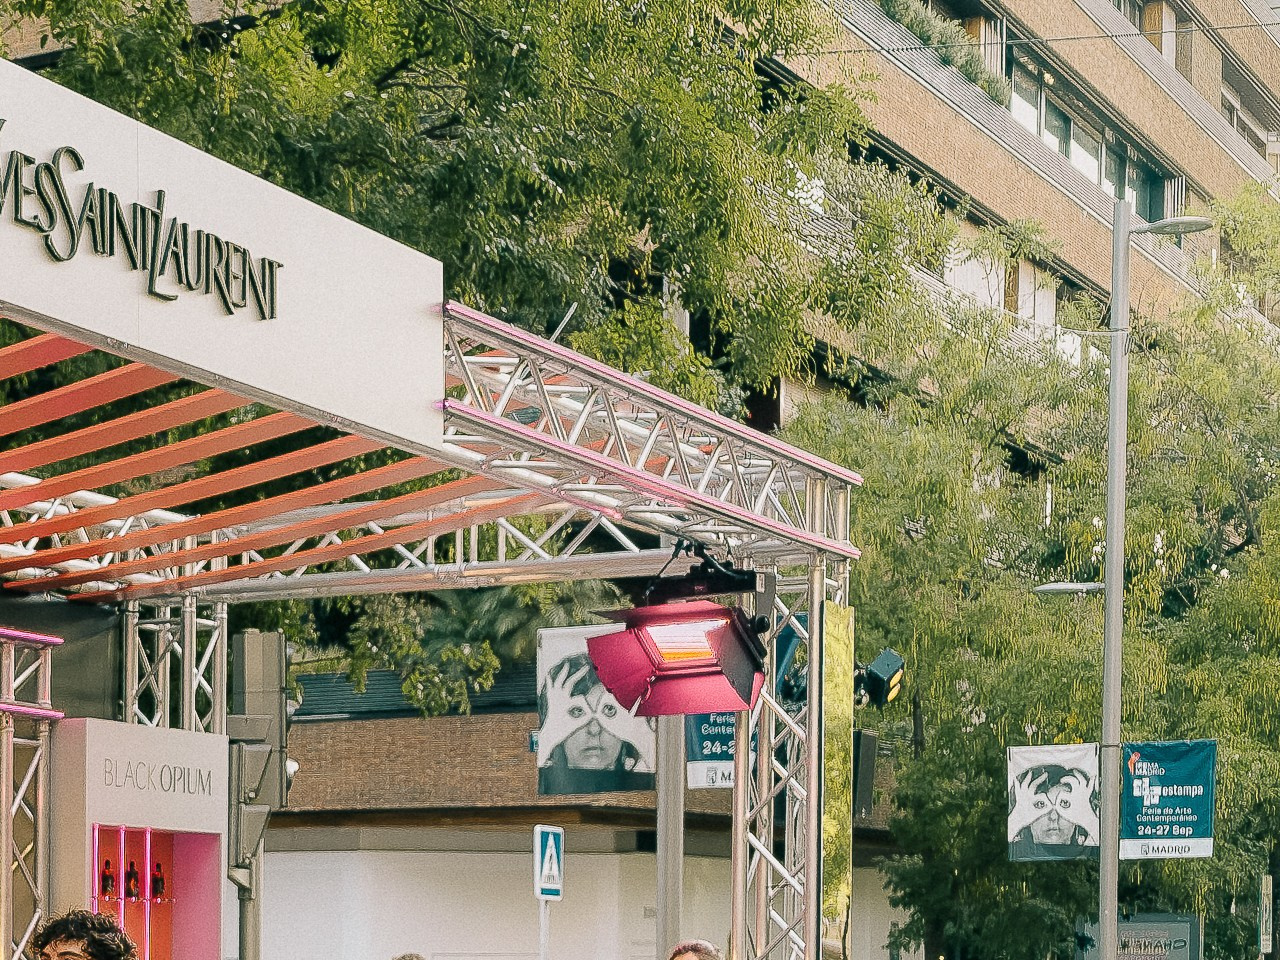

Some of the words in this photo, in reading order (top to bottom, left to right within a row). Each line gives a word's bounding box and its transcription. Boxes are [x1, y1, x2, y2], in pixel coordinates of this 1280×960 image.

[702, 740, 736, 755] 24-2
[104, 758, 157, 790] BLACK
[160, 764, 212, 796] OPIUM
[1162, 785, 1204, 798] estampa
[1163, 807, 1173, 815] de
[1151, 845, 1191, 854] MADRID
